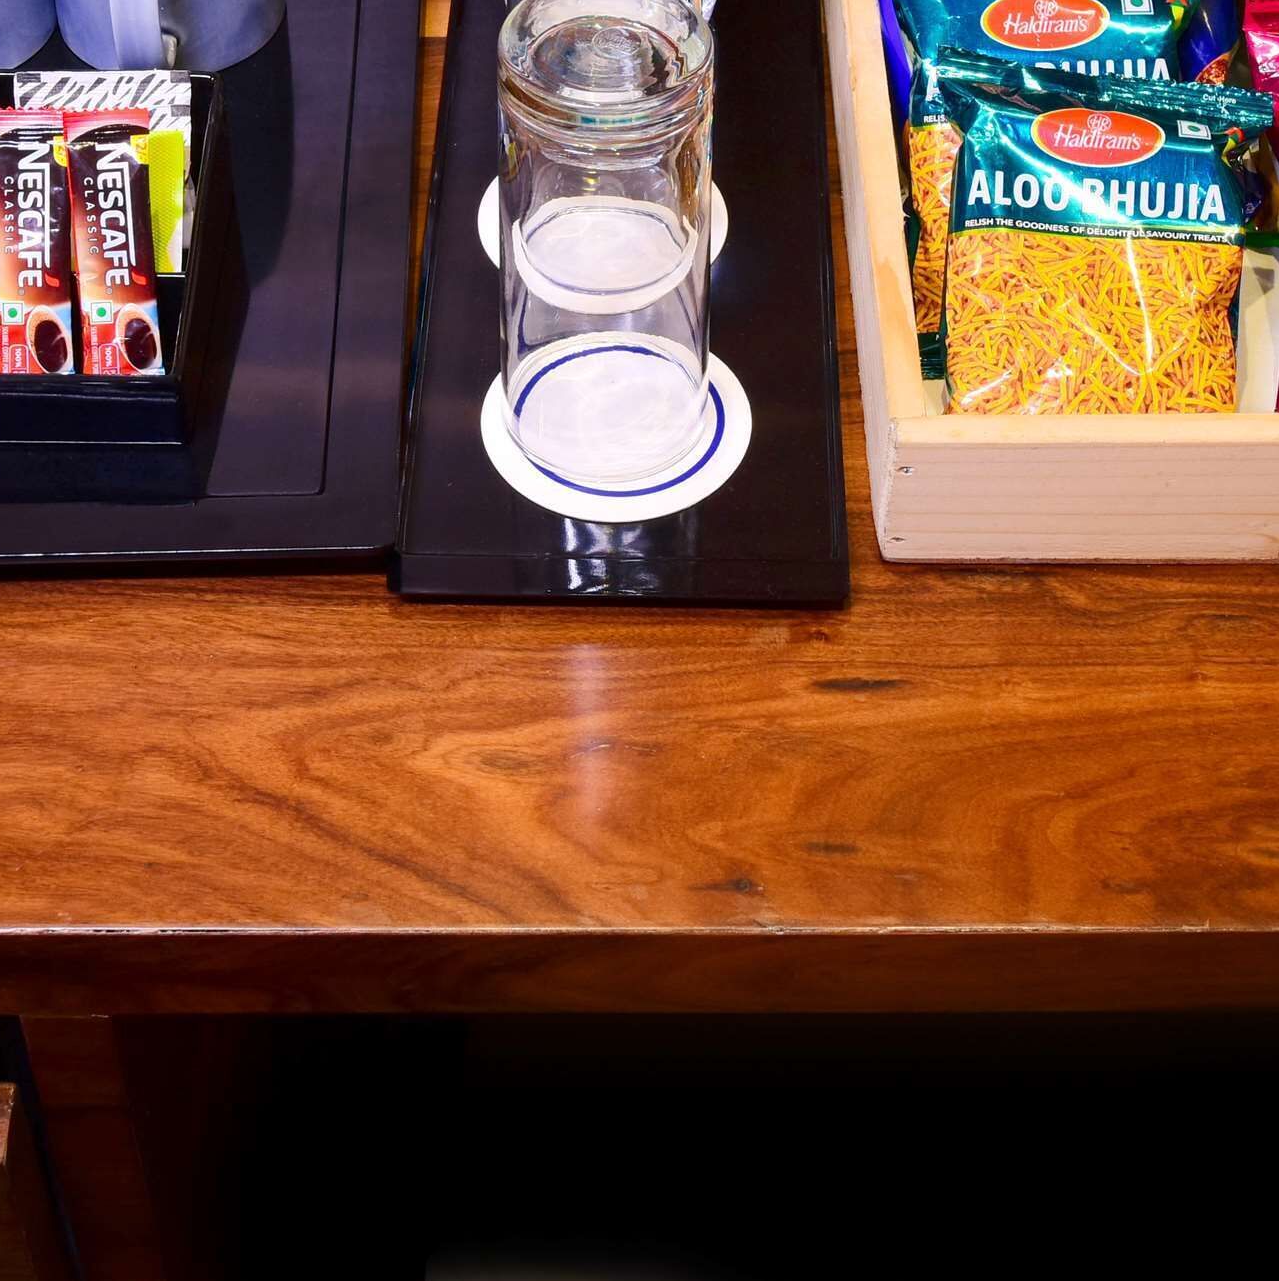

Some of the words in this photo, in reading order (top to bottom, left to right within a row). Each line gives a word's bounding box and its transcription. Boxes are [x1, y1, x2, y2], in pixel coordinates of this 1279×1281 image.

[1003, 12, 1088, 35] Haldiram's
[923, 114, 948, 123] RELIS
[1053, 123, 1141, 150] Haldiram's
[967, 169, 1068, 212] ALOO
[1082, 176, 1226, 222] BHUJIA
[4, 175, 15, 255] CLASSIC
[83, 176, 99, 255] CLASSIC
[965, 217, 994, 227] RELISH
[995, 218, 1014, 228] THE
[1015, 219, 1069, 233] GOODNESS
[1071, 225, 1085, 235] OF
[1086, 226, 1145, 238] DELIGHTFUL
[1145, 230, 1191, 241] SAVOURY
[1192, 233, 1228, 243] TREATS
[14, 348, 22, 368] 100%
[104, 346, 113, 367] 100%
